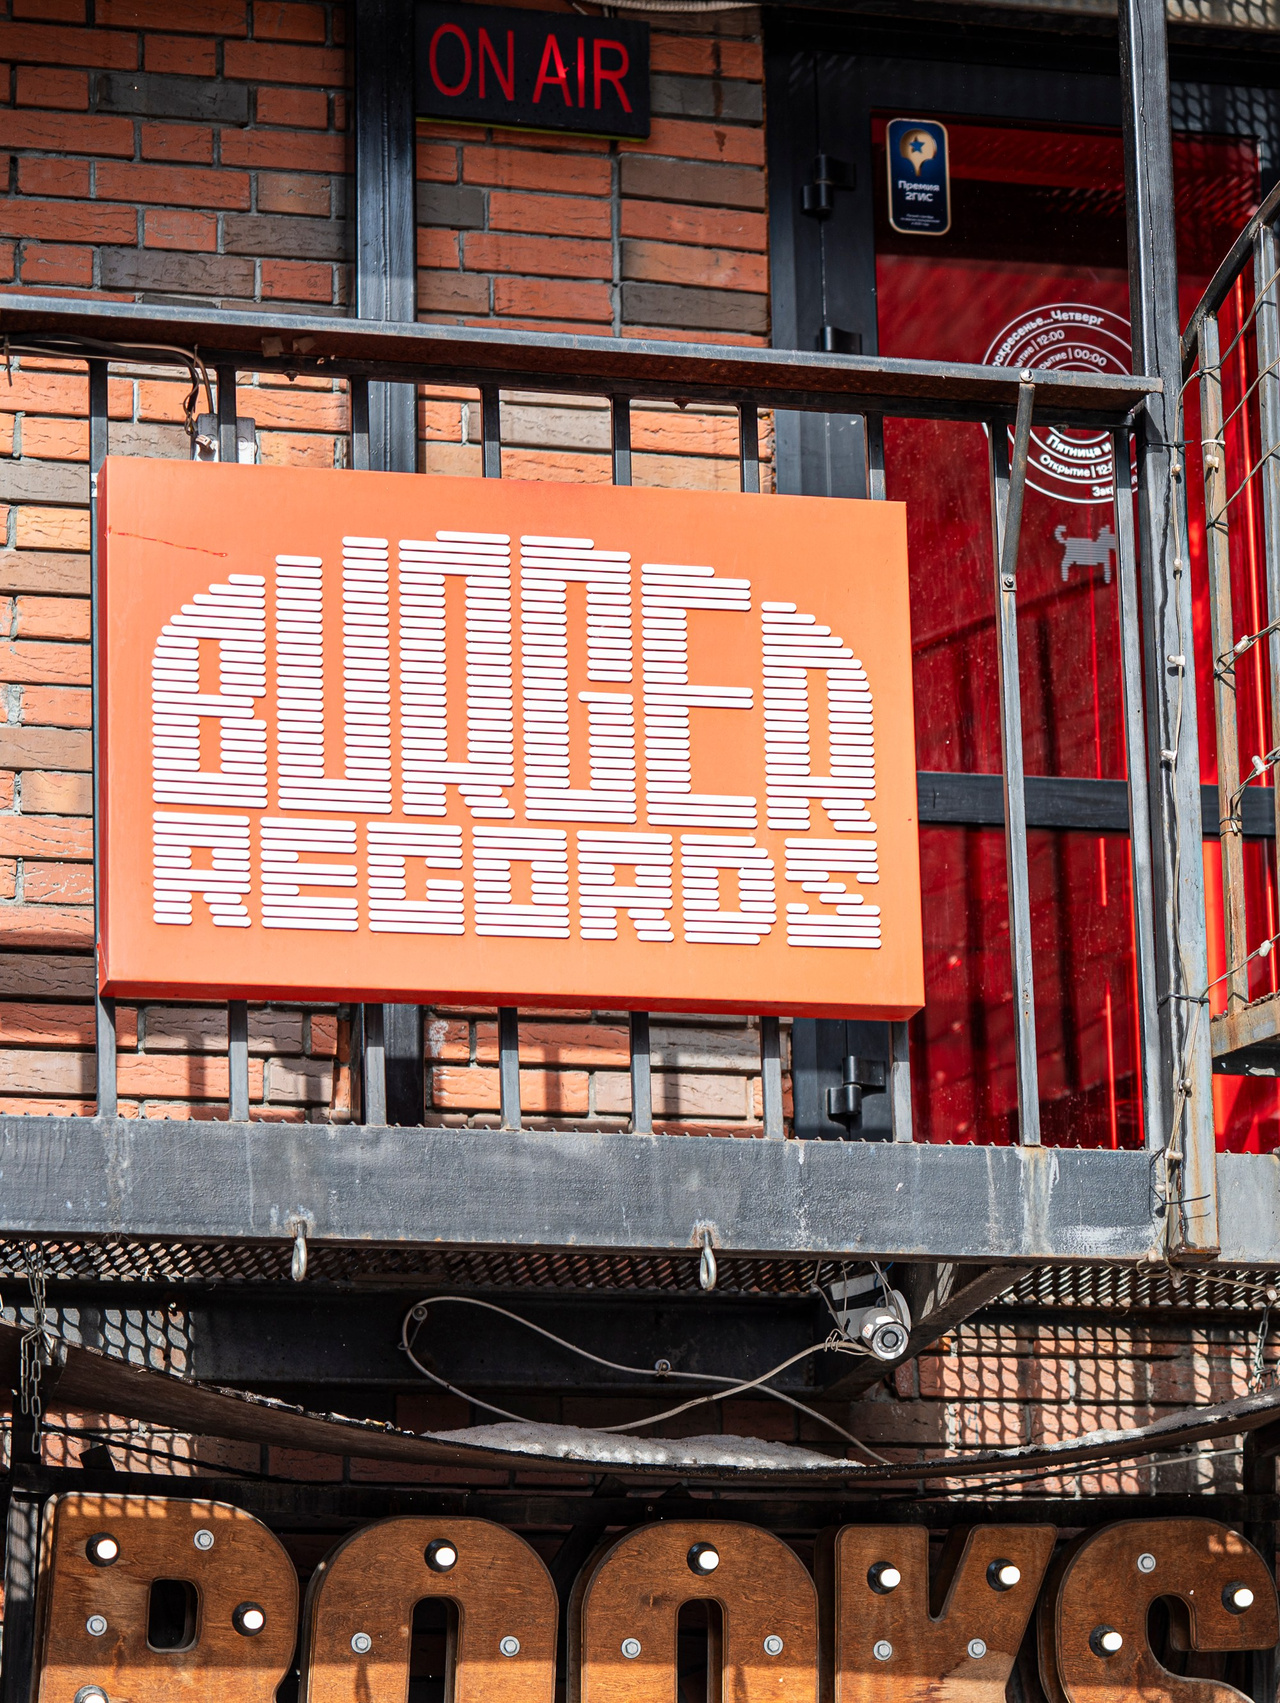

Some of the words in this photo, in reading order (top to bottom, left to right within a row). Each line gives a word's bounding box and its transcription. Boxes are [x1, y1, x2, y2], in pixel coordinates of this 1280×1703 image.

[429, 23, 515, 101] ON
[532, 34, 633, 113] AIR
[898, 180, 940, 191] Премия
[905, 192, 934, 202] 2ГИС
[1037, 329, 1066, 346] 12:00
[1074, 349, 1108, 367] 00:00
[1046, 434, 1102, 459] Пятница
[1039, 454, 1091, 478] Открытие
[152, 531, 878, 834] BURGER
[152, 811, 883, 950] RECORDS
